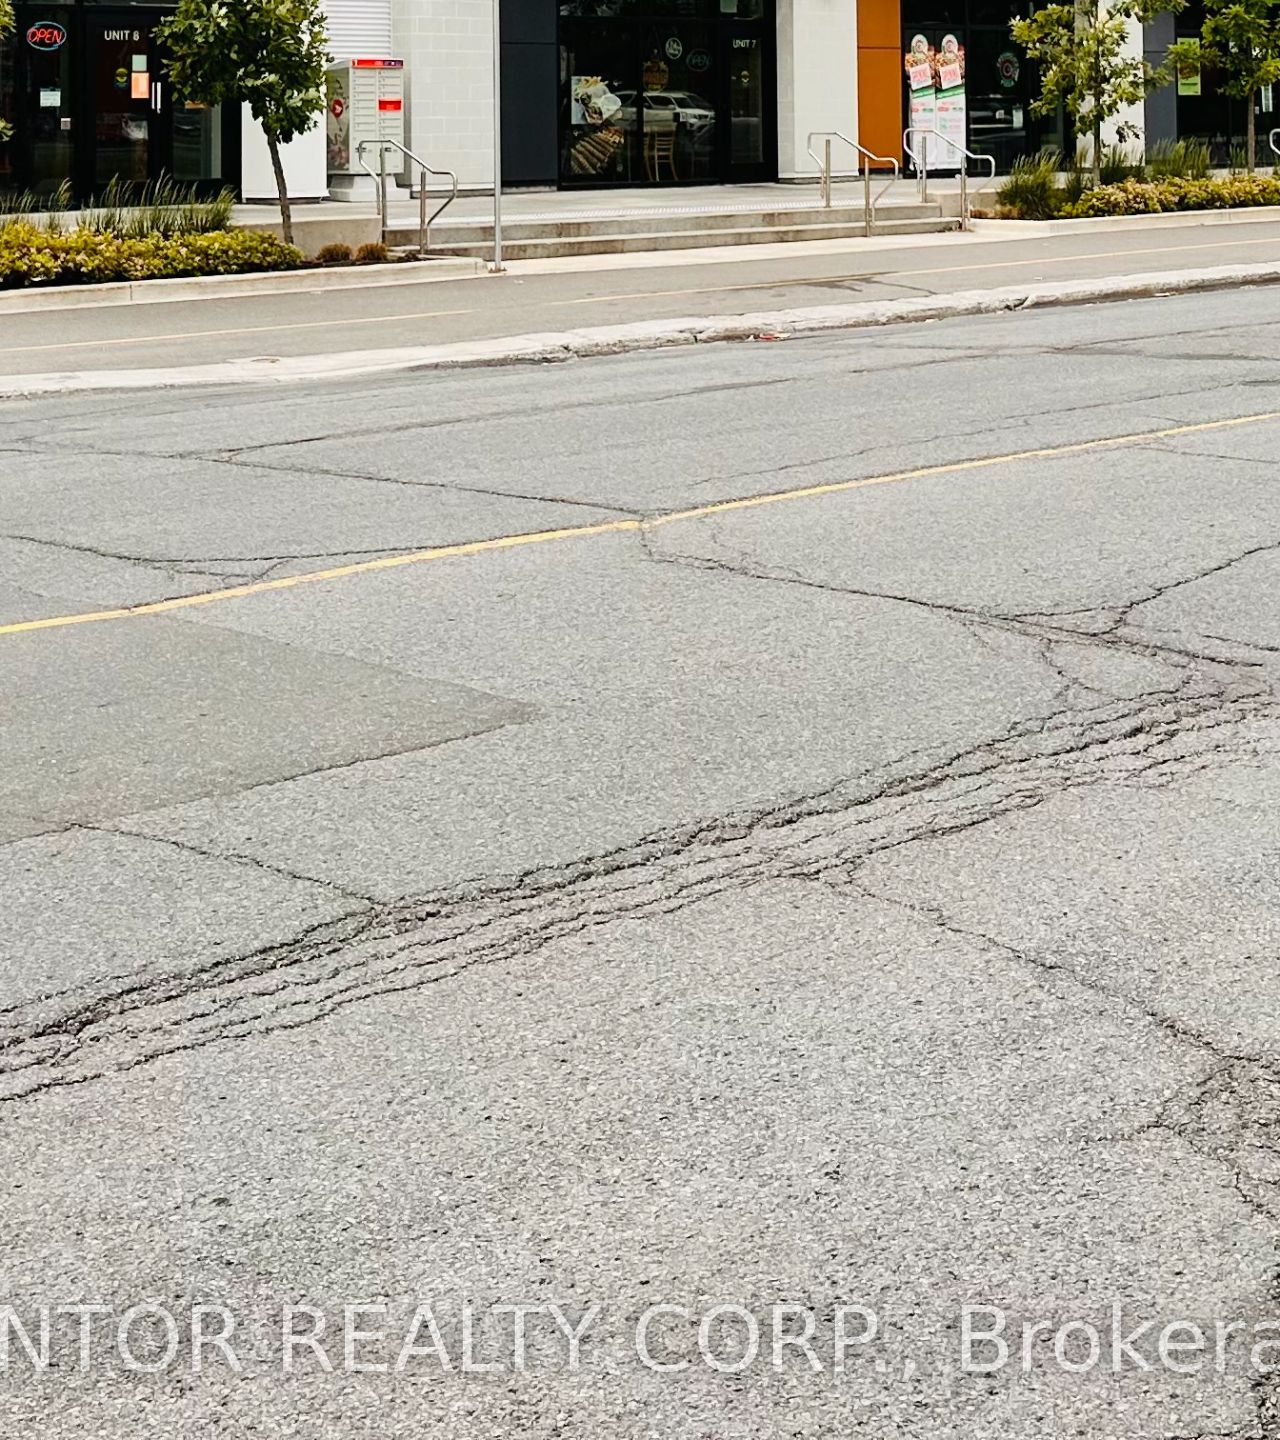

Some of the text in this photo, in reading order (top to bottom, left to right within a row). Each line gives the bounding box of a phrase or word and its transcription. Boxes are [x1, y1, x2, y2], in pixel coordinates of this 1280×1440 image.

[28, 27, 62, 44] OPEN
[104, 30, 140, 40] UNIT 8
[732, 39, 750, 49] UNIT
